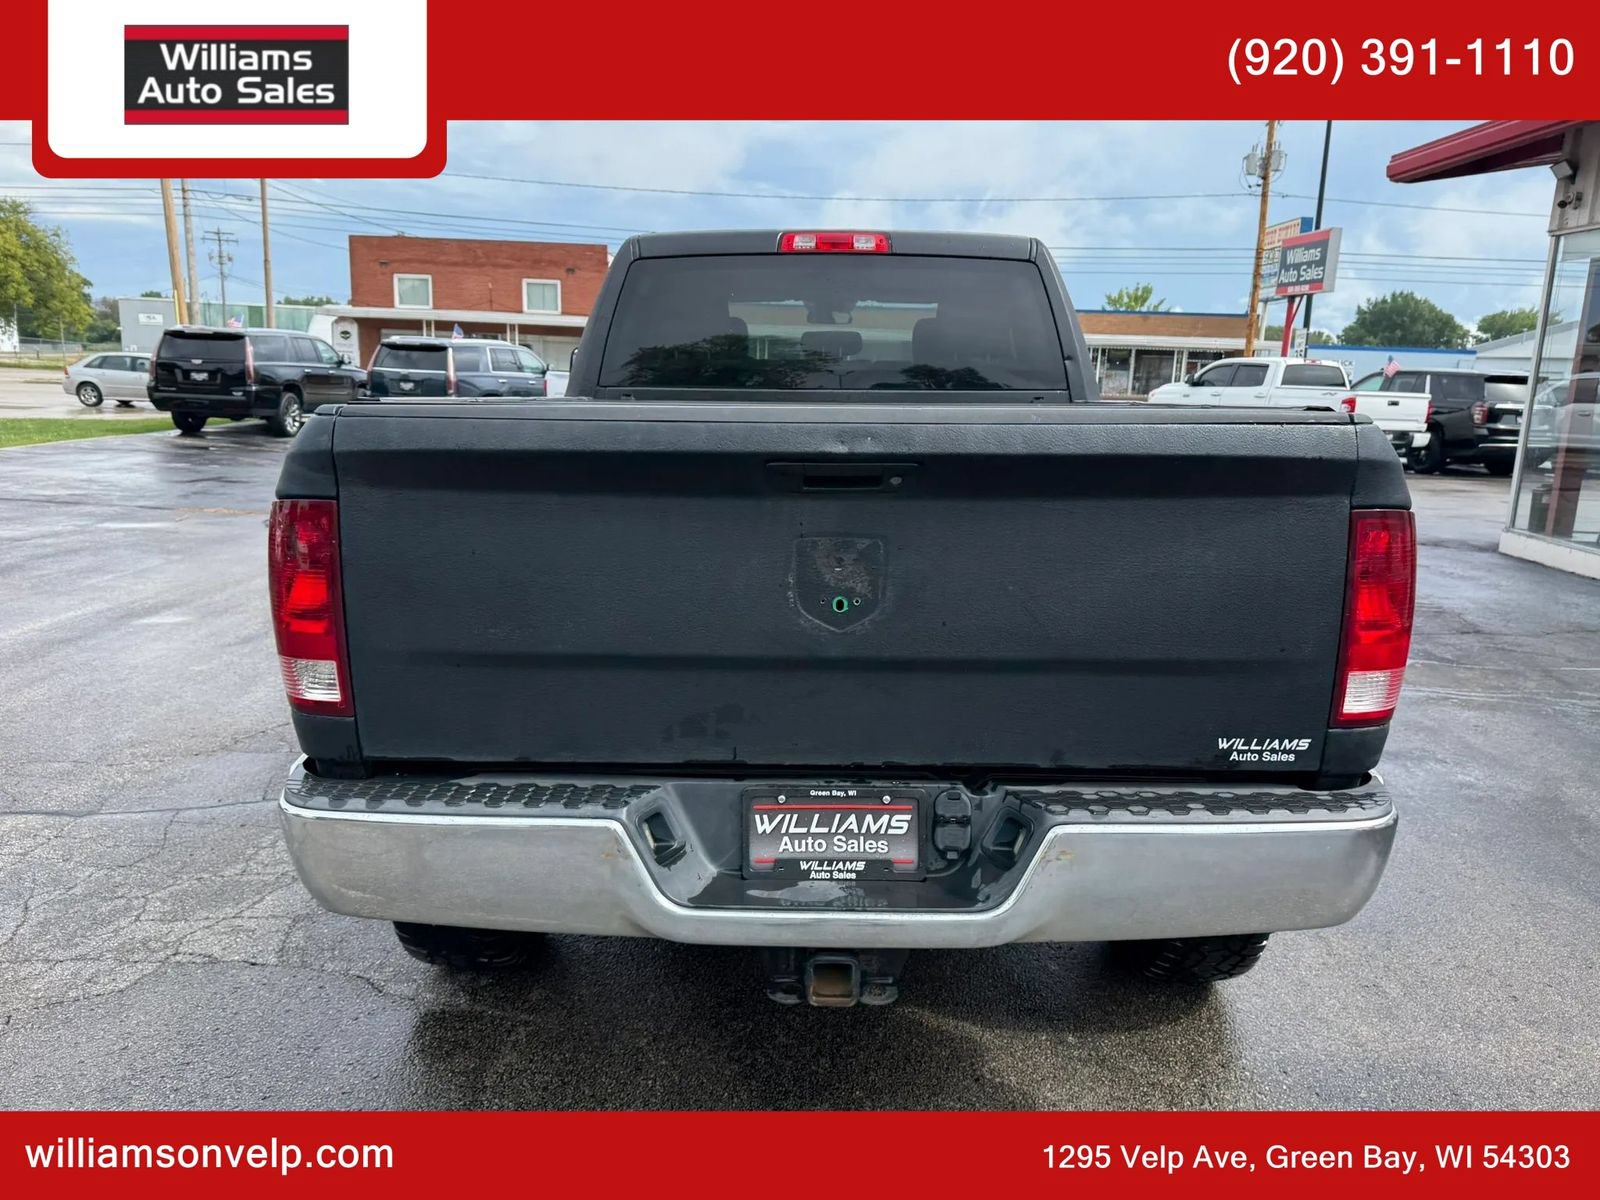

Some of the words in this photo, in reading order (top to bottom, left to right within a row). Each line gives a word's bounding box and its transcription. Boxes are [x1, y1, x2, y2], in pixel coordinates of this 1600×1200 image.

[1286, 247, 1322, 265] Williams
[1278, 267, 1298, 284] Auto
[1299, 264, 1324, 282] Sales
[1218, 737, 1312, 751] WILLIAMS
[1229, 751, 1259, 762] Auto
[1262, 751, 1296, 762] Sales
[809, 789, 831, 797] Green
[831, 789, 847, 798] Bay,
[848, 789, 857, 797] WI
[754, 813, 912, 835] WILLIAMS
[778, 836, 827, 853] Auto
[833, 835, 889, 853] Sales
[799, 860, 867, 871] WILLIAMS
[809, 870, 831, 880] Auto
[832, 870, 857, 880] Sales
